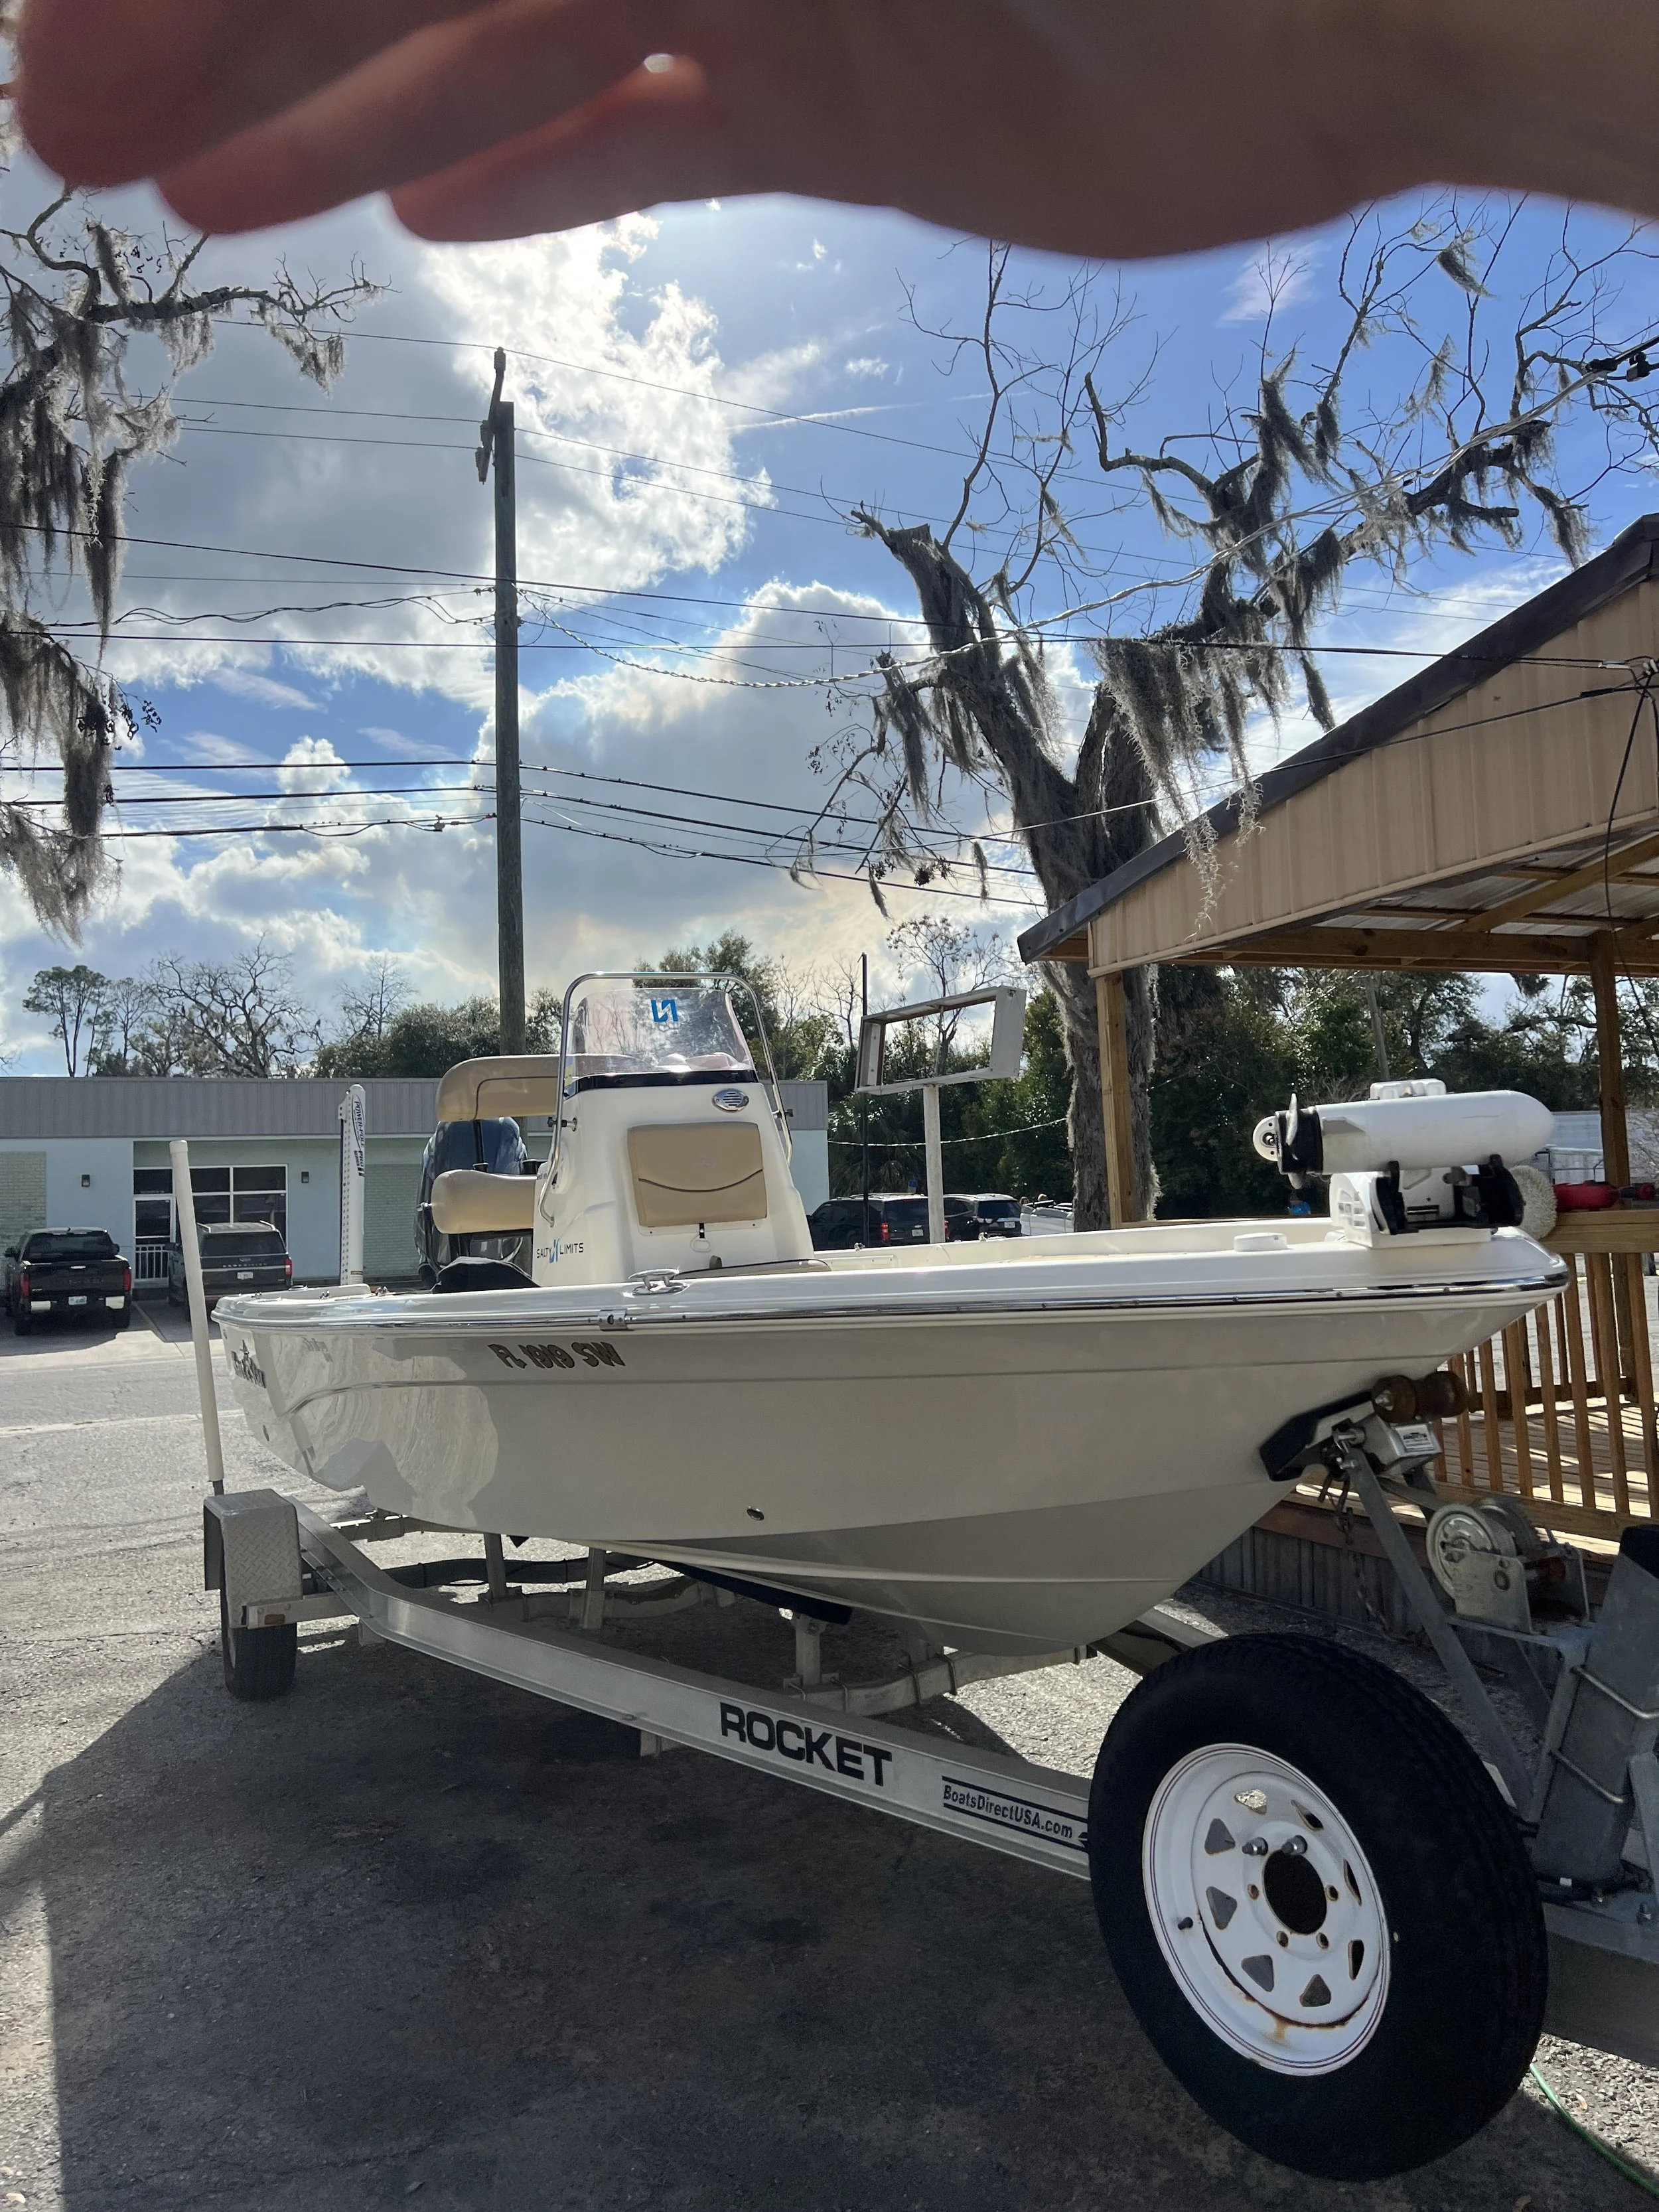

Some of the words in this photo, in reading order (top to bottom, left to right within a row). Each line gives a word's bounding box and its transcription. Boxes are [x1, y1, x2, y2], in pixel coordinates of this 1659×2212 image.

[536, 1247, 552, 1258] SALTY
[559, 1242, 584, 1254] LIMITS
[487, 1343, 528, 1369] FL
[571, 1341, 626, 1367] SW
[719, 1701, 893, 1787] ROCKET
[943, 1784, 1074, 1839] BoatsDirectUSA.com
